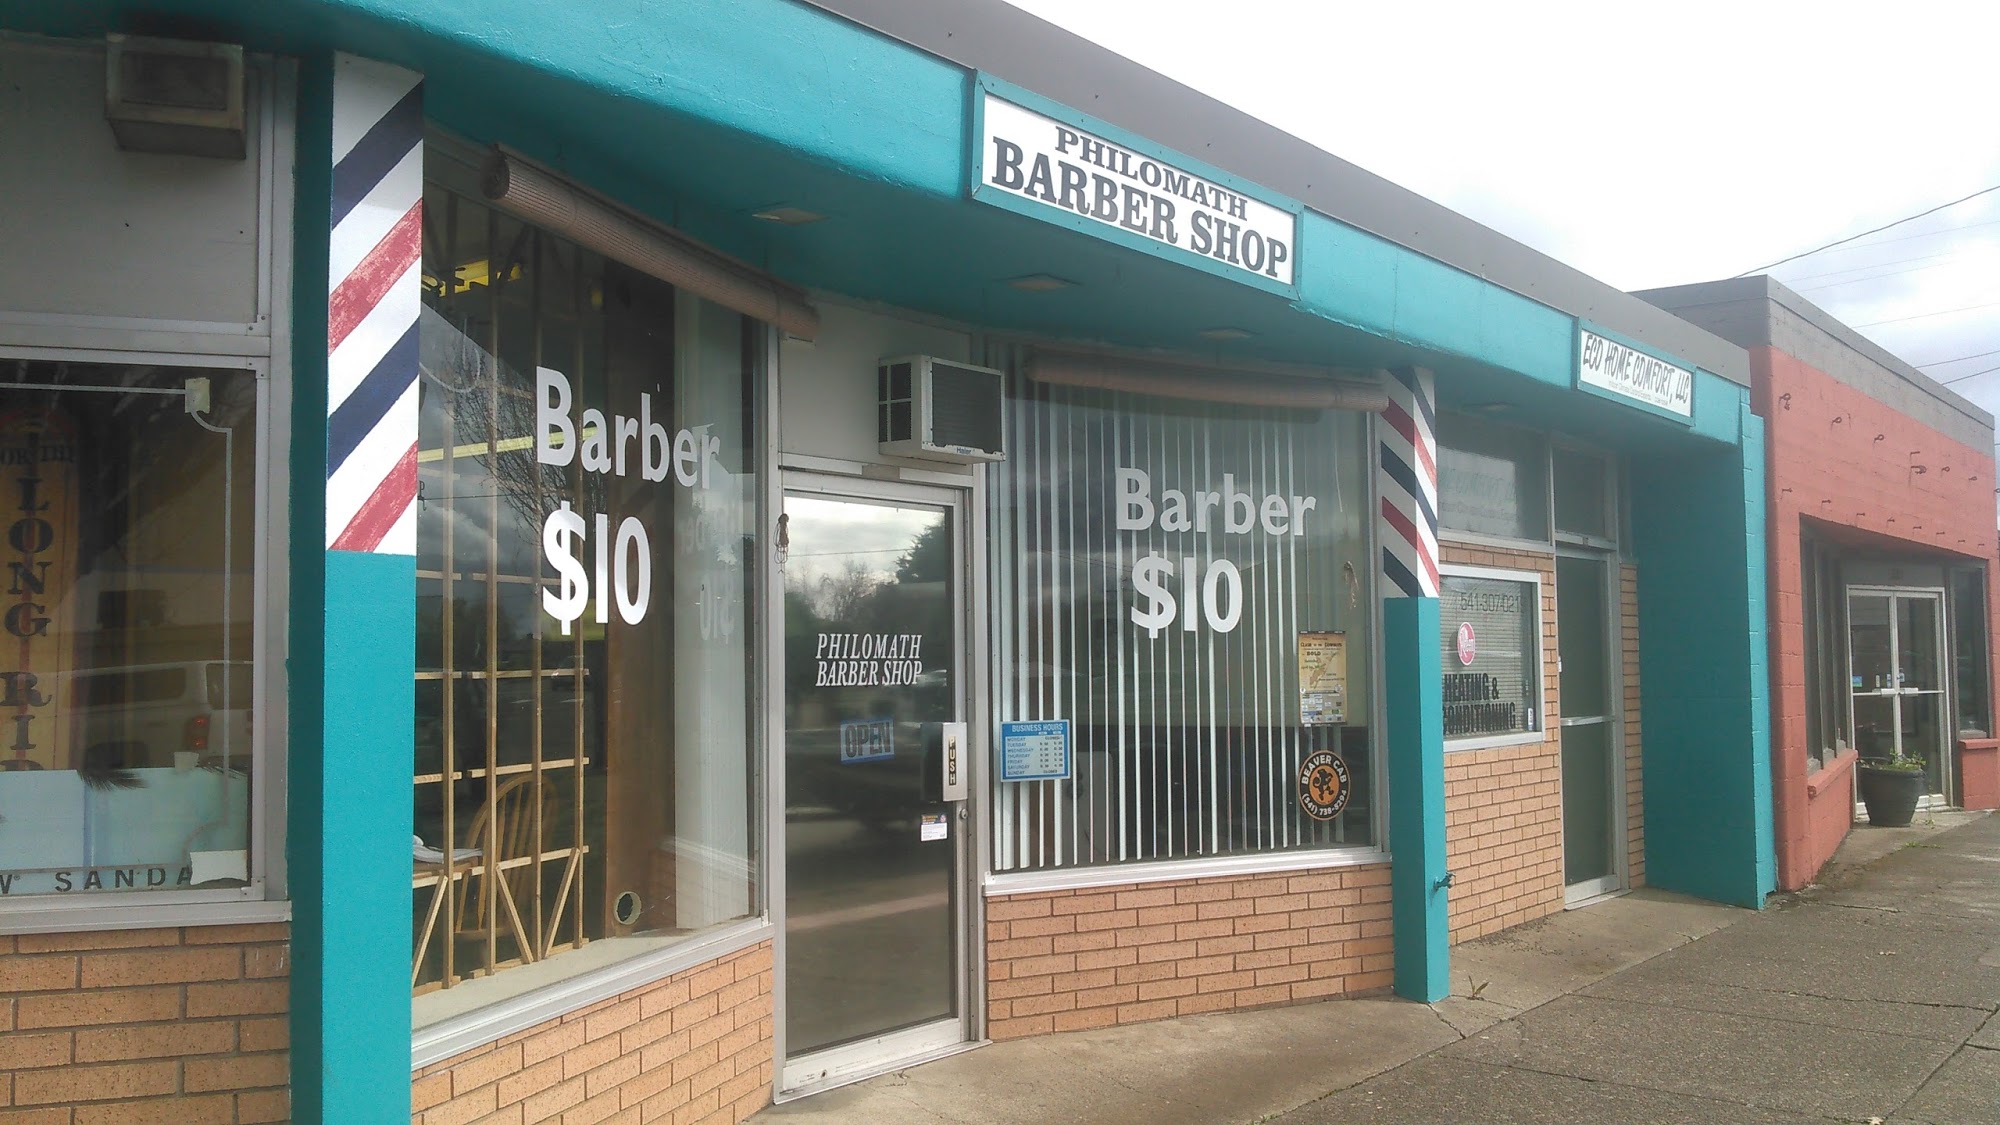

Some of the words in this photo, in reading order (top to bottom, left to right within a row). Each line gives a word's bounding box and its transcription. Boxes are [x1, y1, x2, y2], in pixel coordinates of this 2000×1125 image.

[991, 136, 1178, 244] BARBER
[1190, 210, 1288, 278] SHOP
[1055, 125, 1248, 221] PHILOMATH
[1583, 334, 1604, 372] ECO
[1604, 340, 1634, 381] HOME
[1675, 372, 1690, 405] LLC
[536, 365, 721, 490] Barber
[1116, 467, 1317, 536] Barber
[4, 478, 54, 638] LONG
[542, 500, 651, 636] $10
[1131, 550, 1243, 639] $10
[1460, 592, 1521, 614] 541-307-021
[815, 633, 923, 659] PHILOMATH
[815, 660, 879, 687] BARBER
[881, 660, 923, 686] SHOP
[1443, 672, 1489, 702] HEATING
[1491, 676, 1500, 700] &
[845, 721, 891, 758] OPEN
[1012, 724, 1042, 732] BUSINESS
[1043, 723, 1064, 731] HOURS
[1301, 754, 1332, 785] BEAVER
[1333, 760, 1347, 783] CAB
